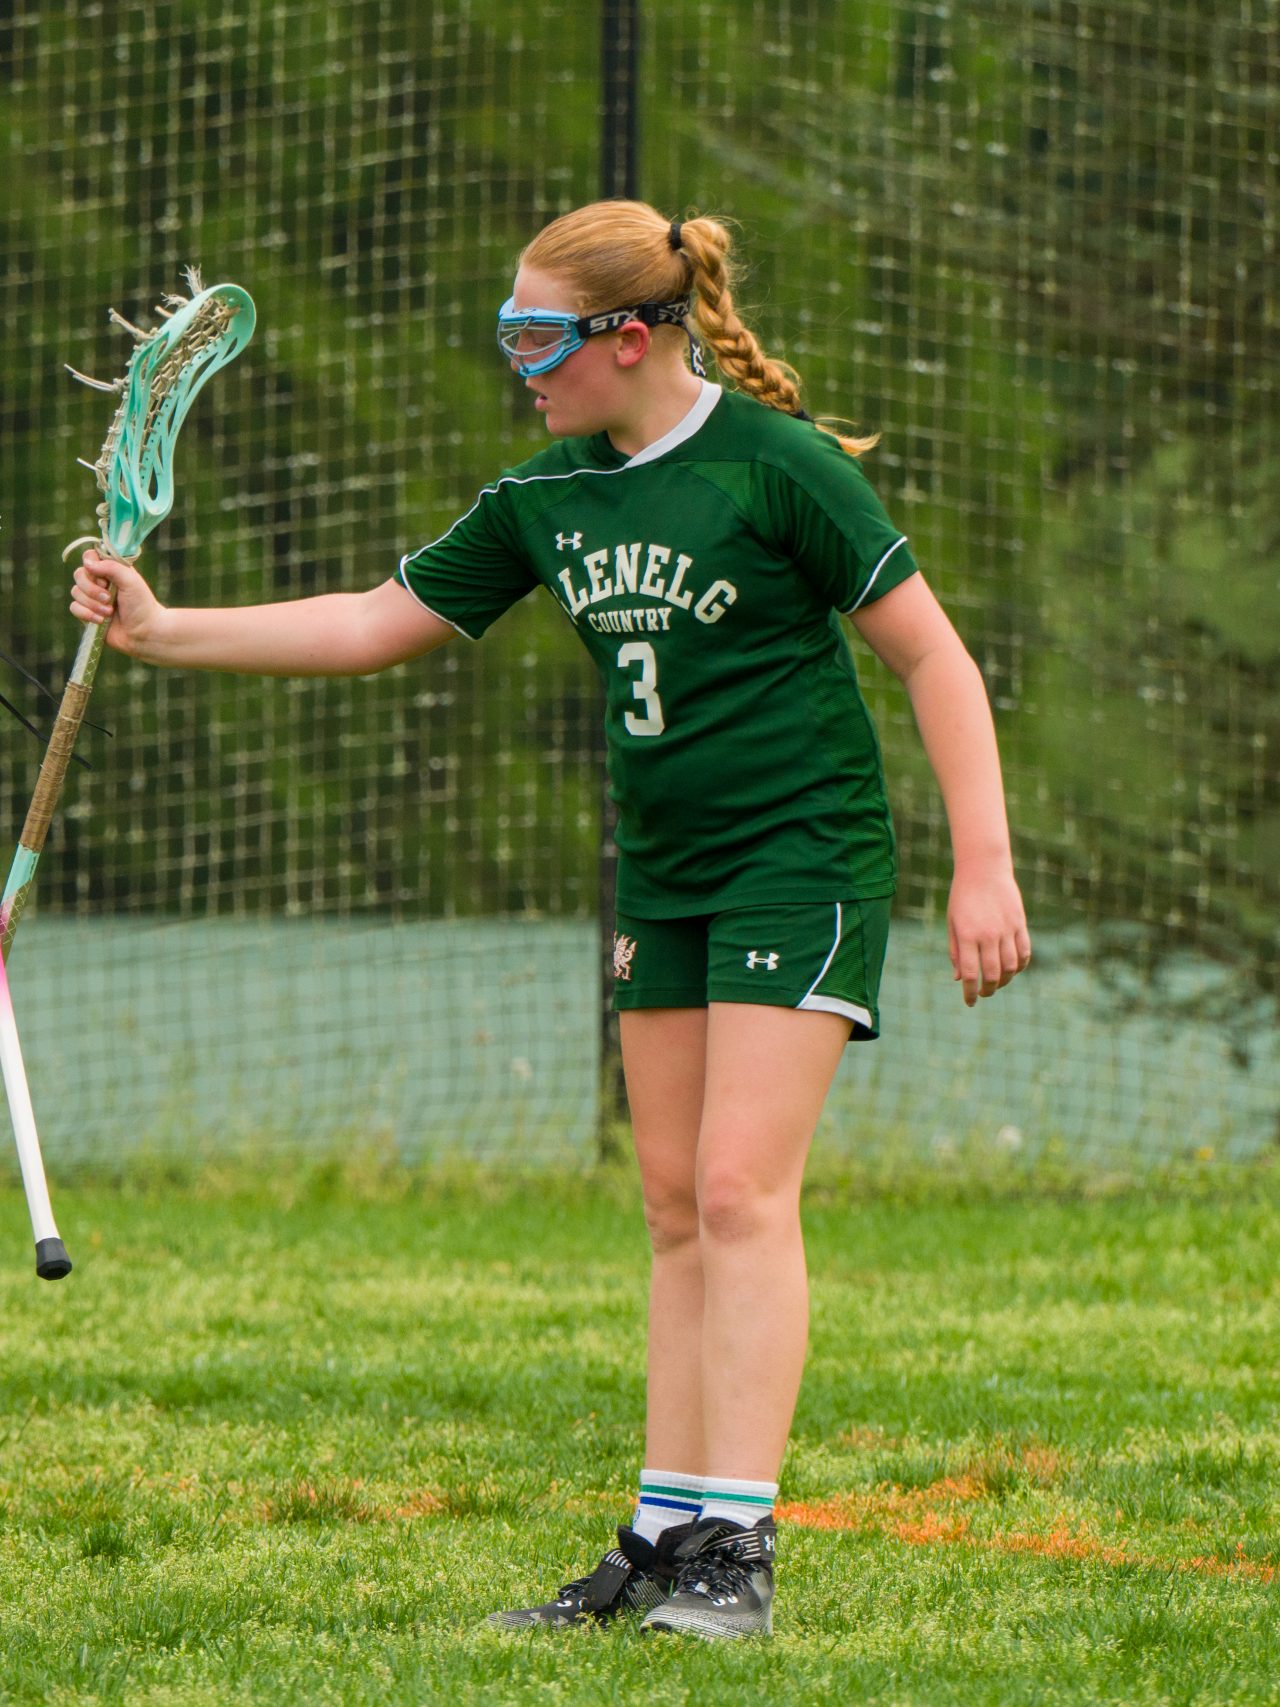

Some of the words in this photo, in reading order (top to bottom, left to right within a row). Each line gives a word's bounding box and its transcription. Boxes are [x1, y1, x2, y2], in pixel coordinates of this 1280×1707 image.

[589, 308, 640, 334] STX
[550, 543, 737, 624] LENELG
[588, 607, 672, 632] COUNTRY
[617, 641, 665, 736] 3
